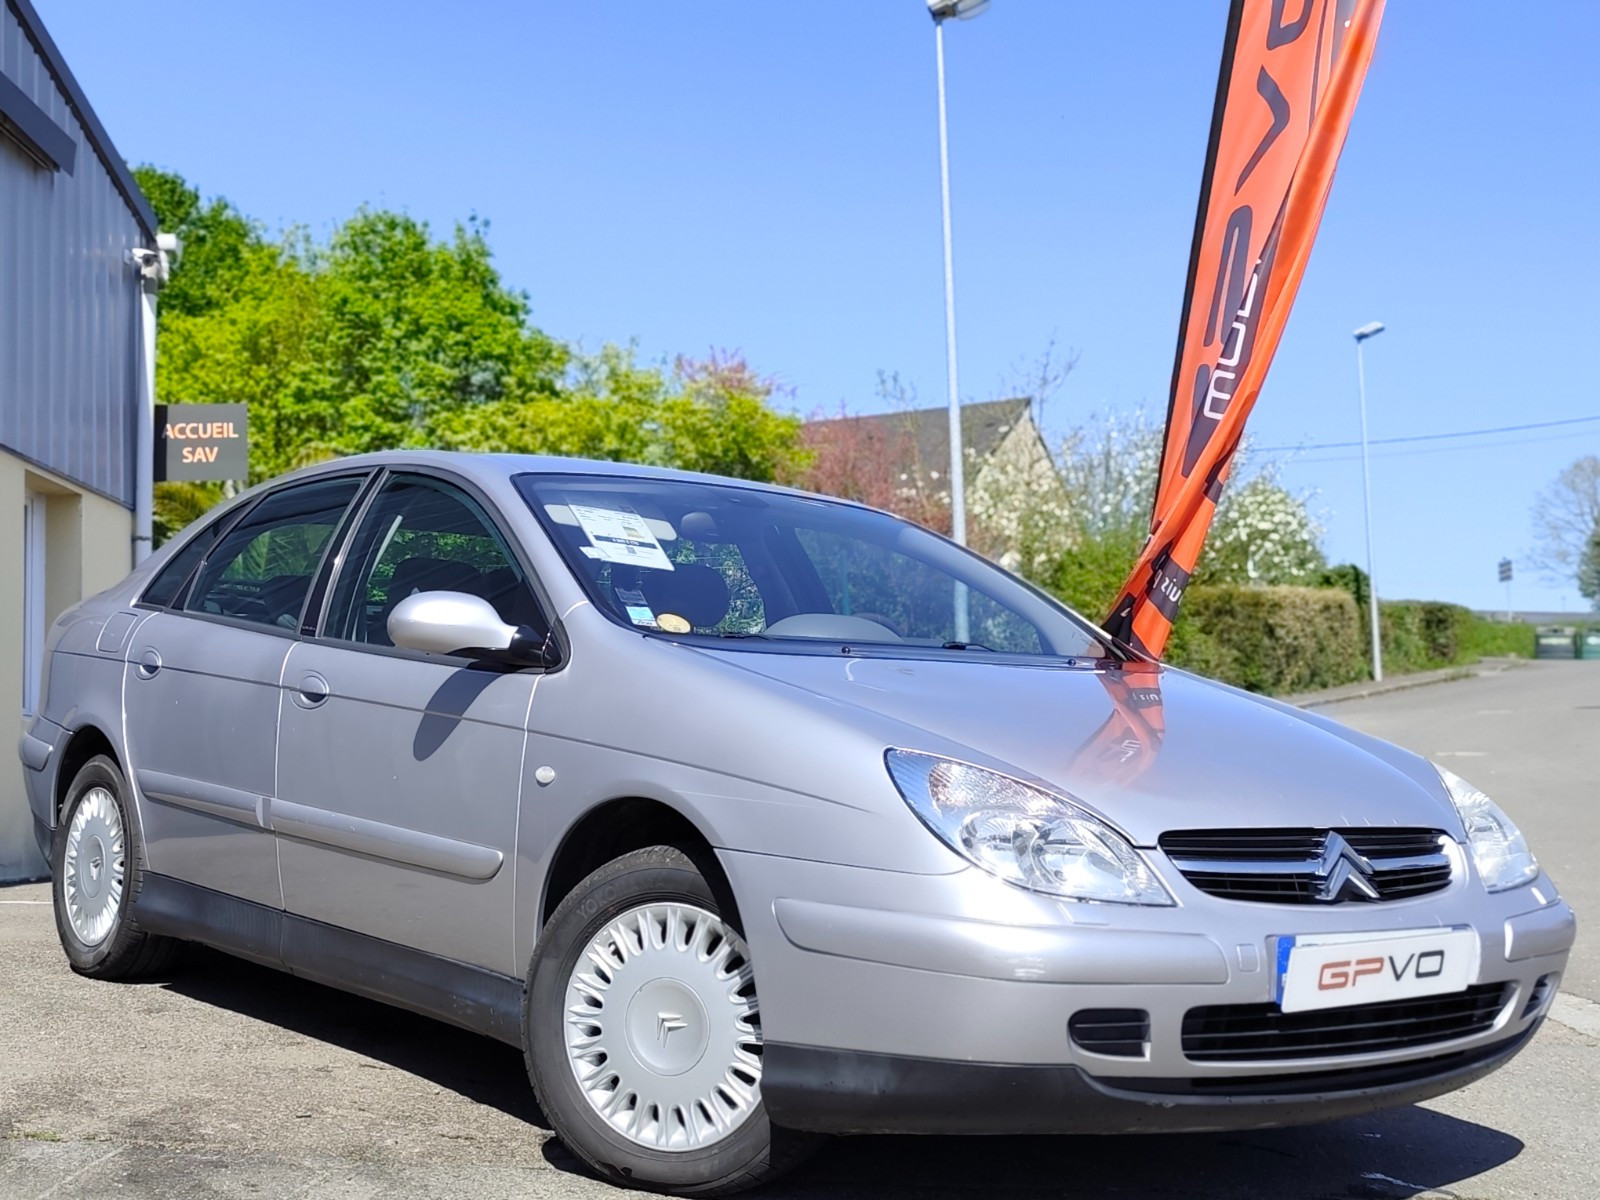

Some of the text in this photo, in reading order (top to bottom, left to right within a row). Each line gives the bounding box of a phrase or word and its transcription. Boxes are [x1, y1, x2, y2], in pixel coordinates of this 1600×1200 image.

[162, 422, 239, 439] ACCUEIL
[182, 446, 218, 463] SAV
[1318, 949, 1445, 991] GPVO
